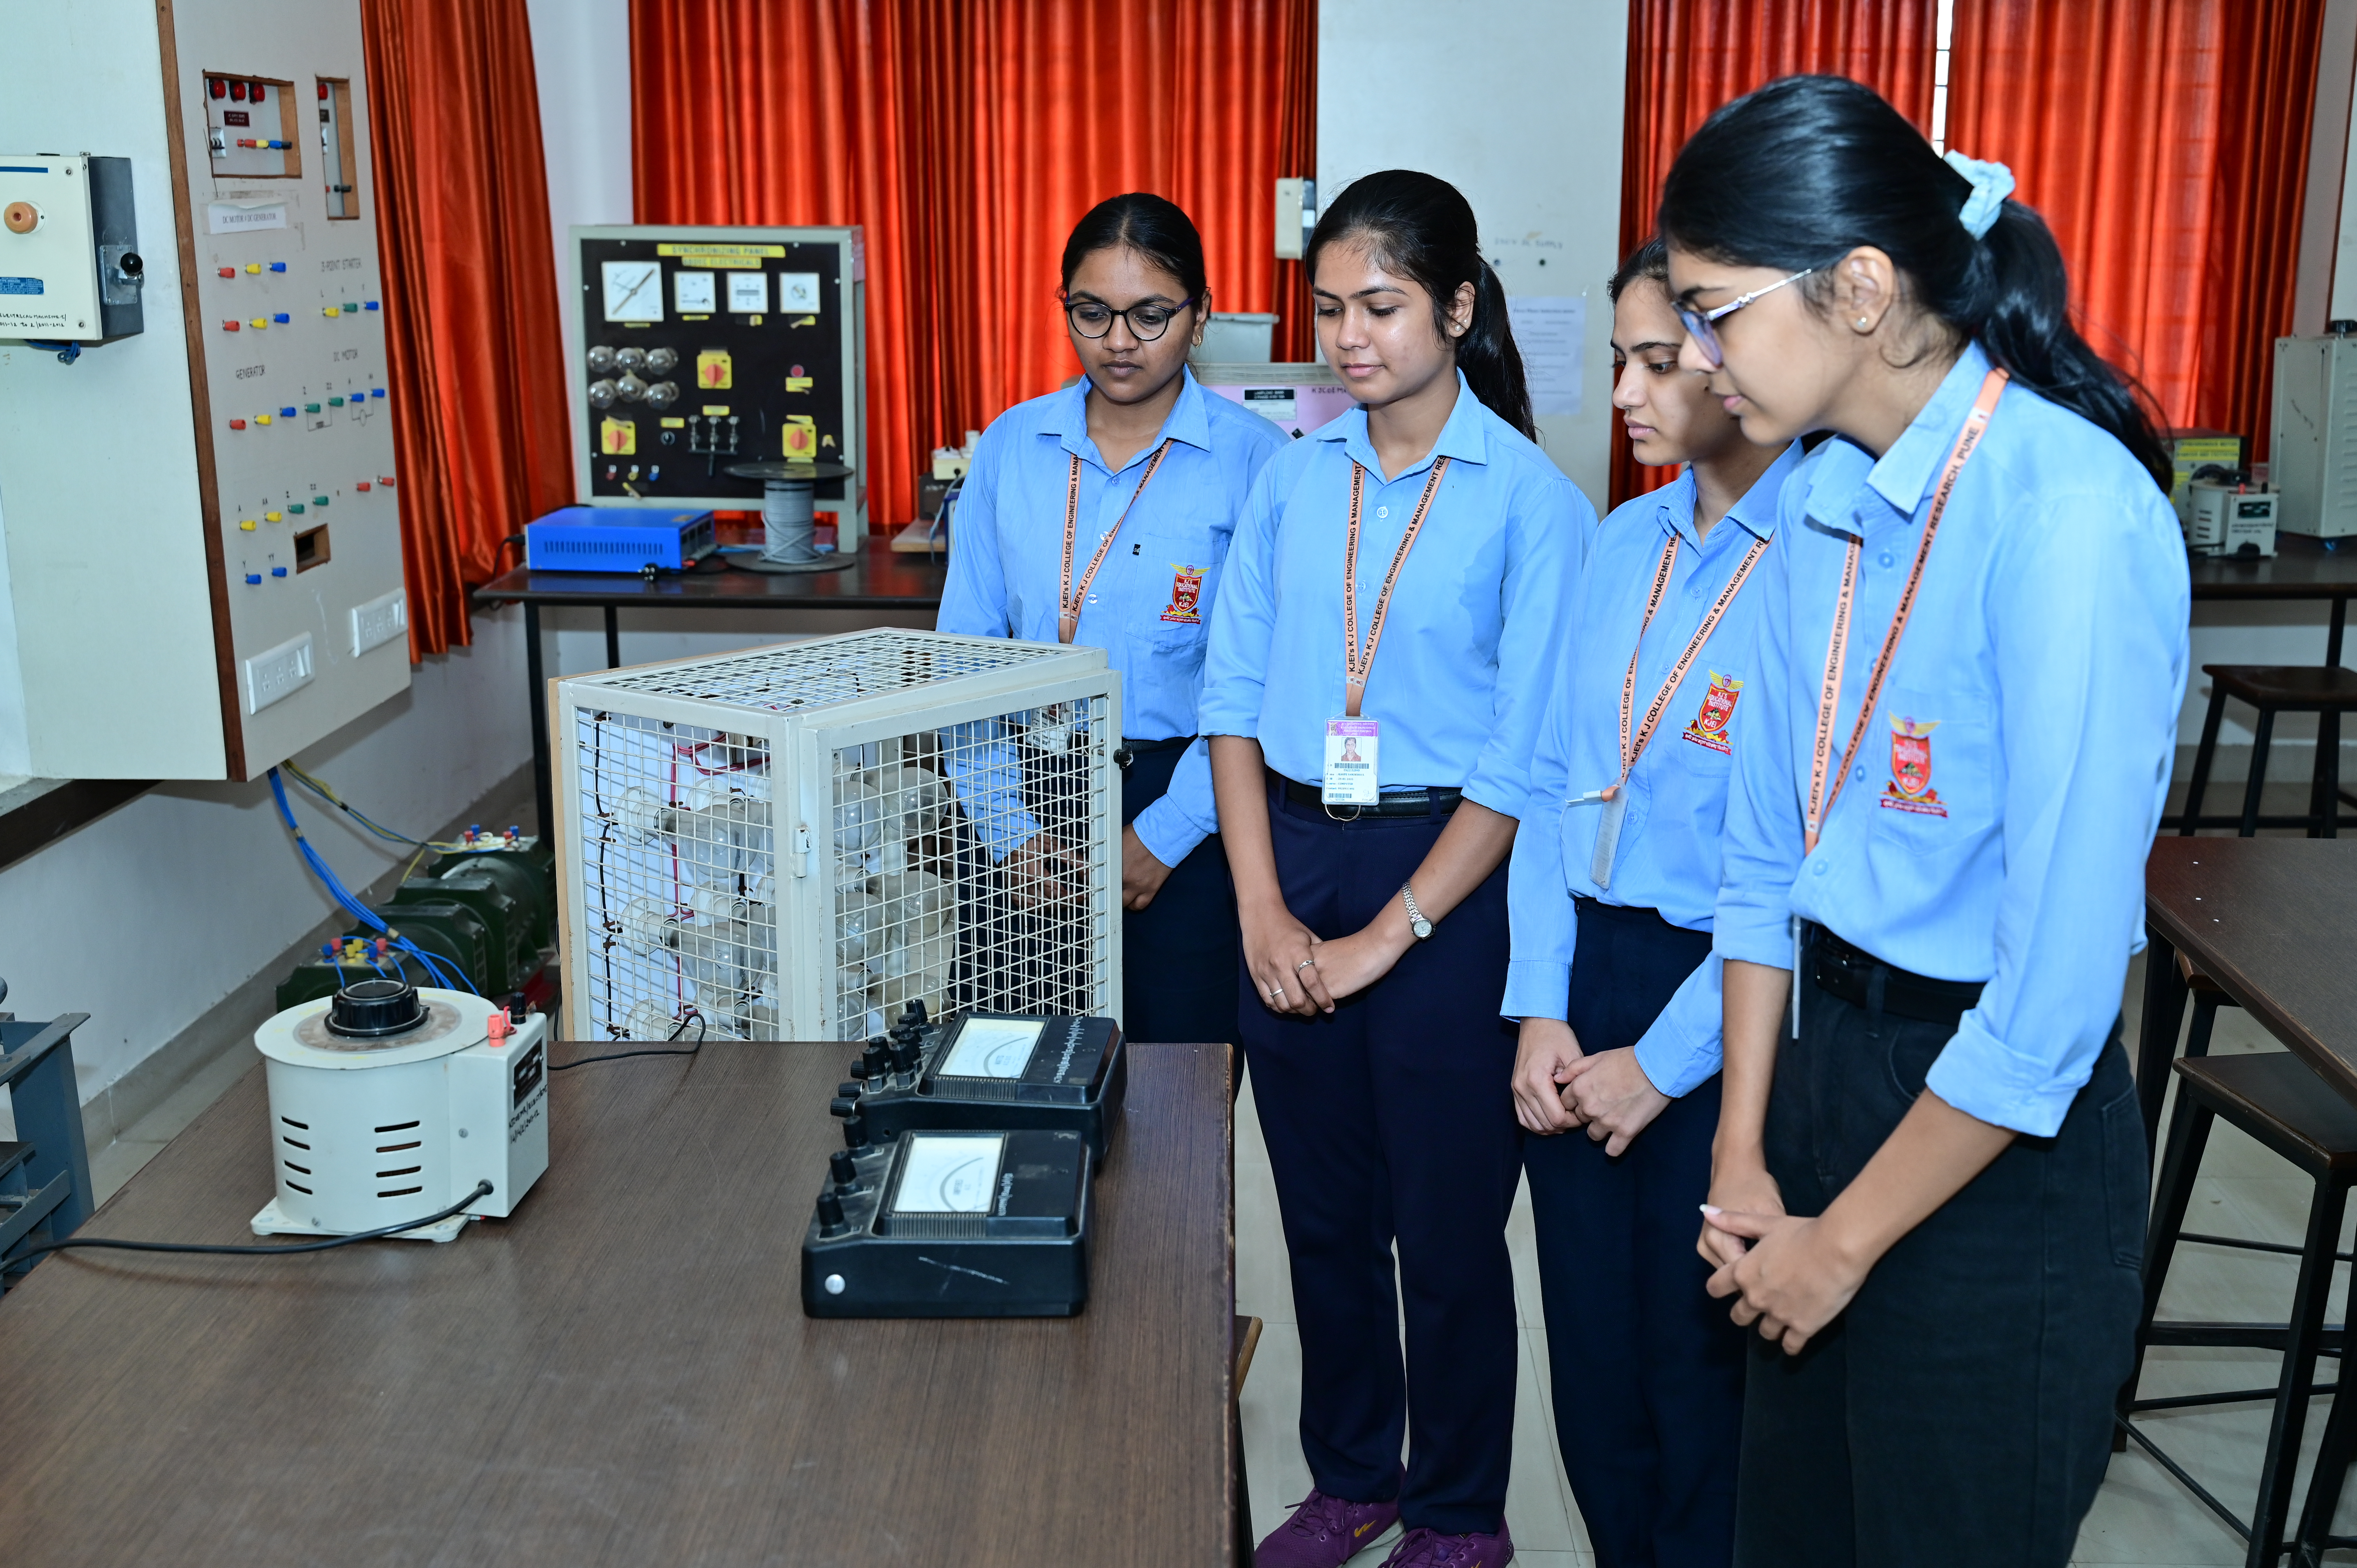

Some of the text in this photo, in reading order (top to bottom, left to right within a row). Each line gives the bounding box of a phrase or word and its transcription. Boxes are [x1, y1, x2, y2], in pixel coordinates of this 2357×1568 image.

[223, 216, 229, 224] DC
[230, 215, 244, 224] MOTOR
[254, 213, 277, 222] GENERATOR
[236, 364, 265, 380] GENERATOR
[1068, 483, 1076, 529] ENGINEERING
[1351, 465, 1361, 518] MANAGEMENT
[1067, 530, 1072, 539] OF
[1072, 592, 1083, 611] KJEI's
[1085, 548, 1104, 579] COLLEGE
[1103, 538, 1109, 547] OF
[1139, 445, 1164, 489] MANAGEMENT
[1901, 533, 1934, 612] MANAGEMENT
[1958, 427, 1979, 459] PUNE
[1346, 527, 1356, 580] ENGINEERING
[1357, 651, 1370, 675] KJEI's
[1370, 598, 1385, 636] COLLEGE
[1381, 585, 1389, 597] OF
[1385, 533, 1412, 584] ENGINEERING
[1412, 471, 1438, 525] MANAGEMENT
[1435, 456, 1447, 471] RES
[1346, 582, 1352, 592] OF
[1622, 691, 1630, 733] COLLEGE
[1626, 677, 1632, 689] OF
[1650, 549, 1673, 607] MANAGEMENT
[1631, 738, 1644, 762] KJEI's
[1647, 685, 1672, 722] COLLEGE
[1670, 671, 1679, 683] OF
[1677, 615, 1715, 670] ENGINEERING
[1717, 550, 1757, 607] MANAGEMENT
[1828, 602, 1847, 681] ENGINEERING
[1708, 694, 1732, 706] EDUCATIONAL
[1708, 700, 1730, 712] INSTITUTE
[1825, 683, 1835, 699] OF
[1704, 719, 1717, 727] KJEI
[1817, 704, 1832, 757] COLLEGE
[1810, 782, 1820, 814] KJEI's
